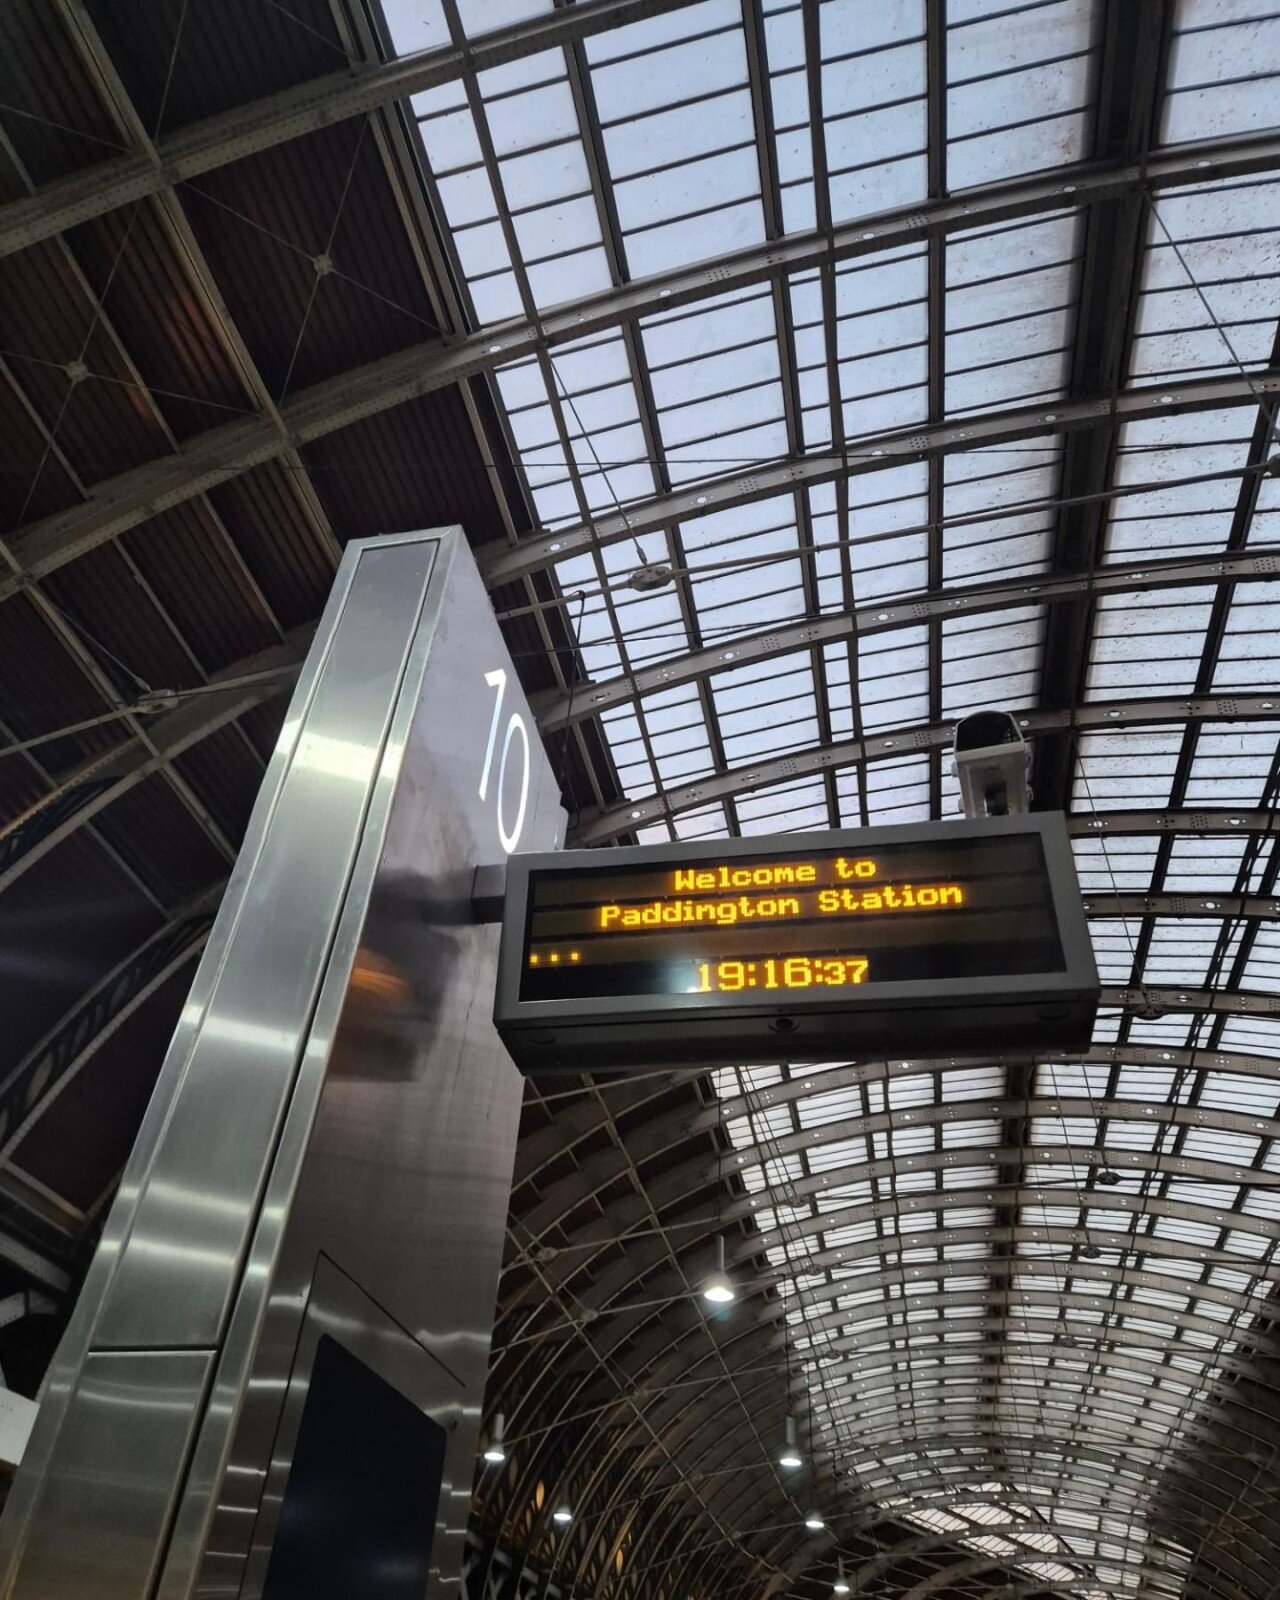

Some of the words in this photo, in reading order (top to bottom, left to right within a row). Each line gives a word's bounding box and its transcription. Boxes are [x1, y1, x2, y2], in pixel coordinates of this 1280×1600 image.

[479, 669, 530, 854] 10
[674, 865, 816, 891] Welcome
[835, 857, 876, 879] to
[600, 896, 799, 928] Paddington
[818, 884, 963, 912] Station
[698, 957, 869, 992] 19:16:37
